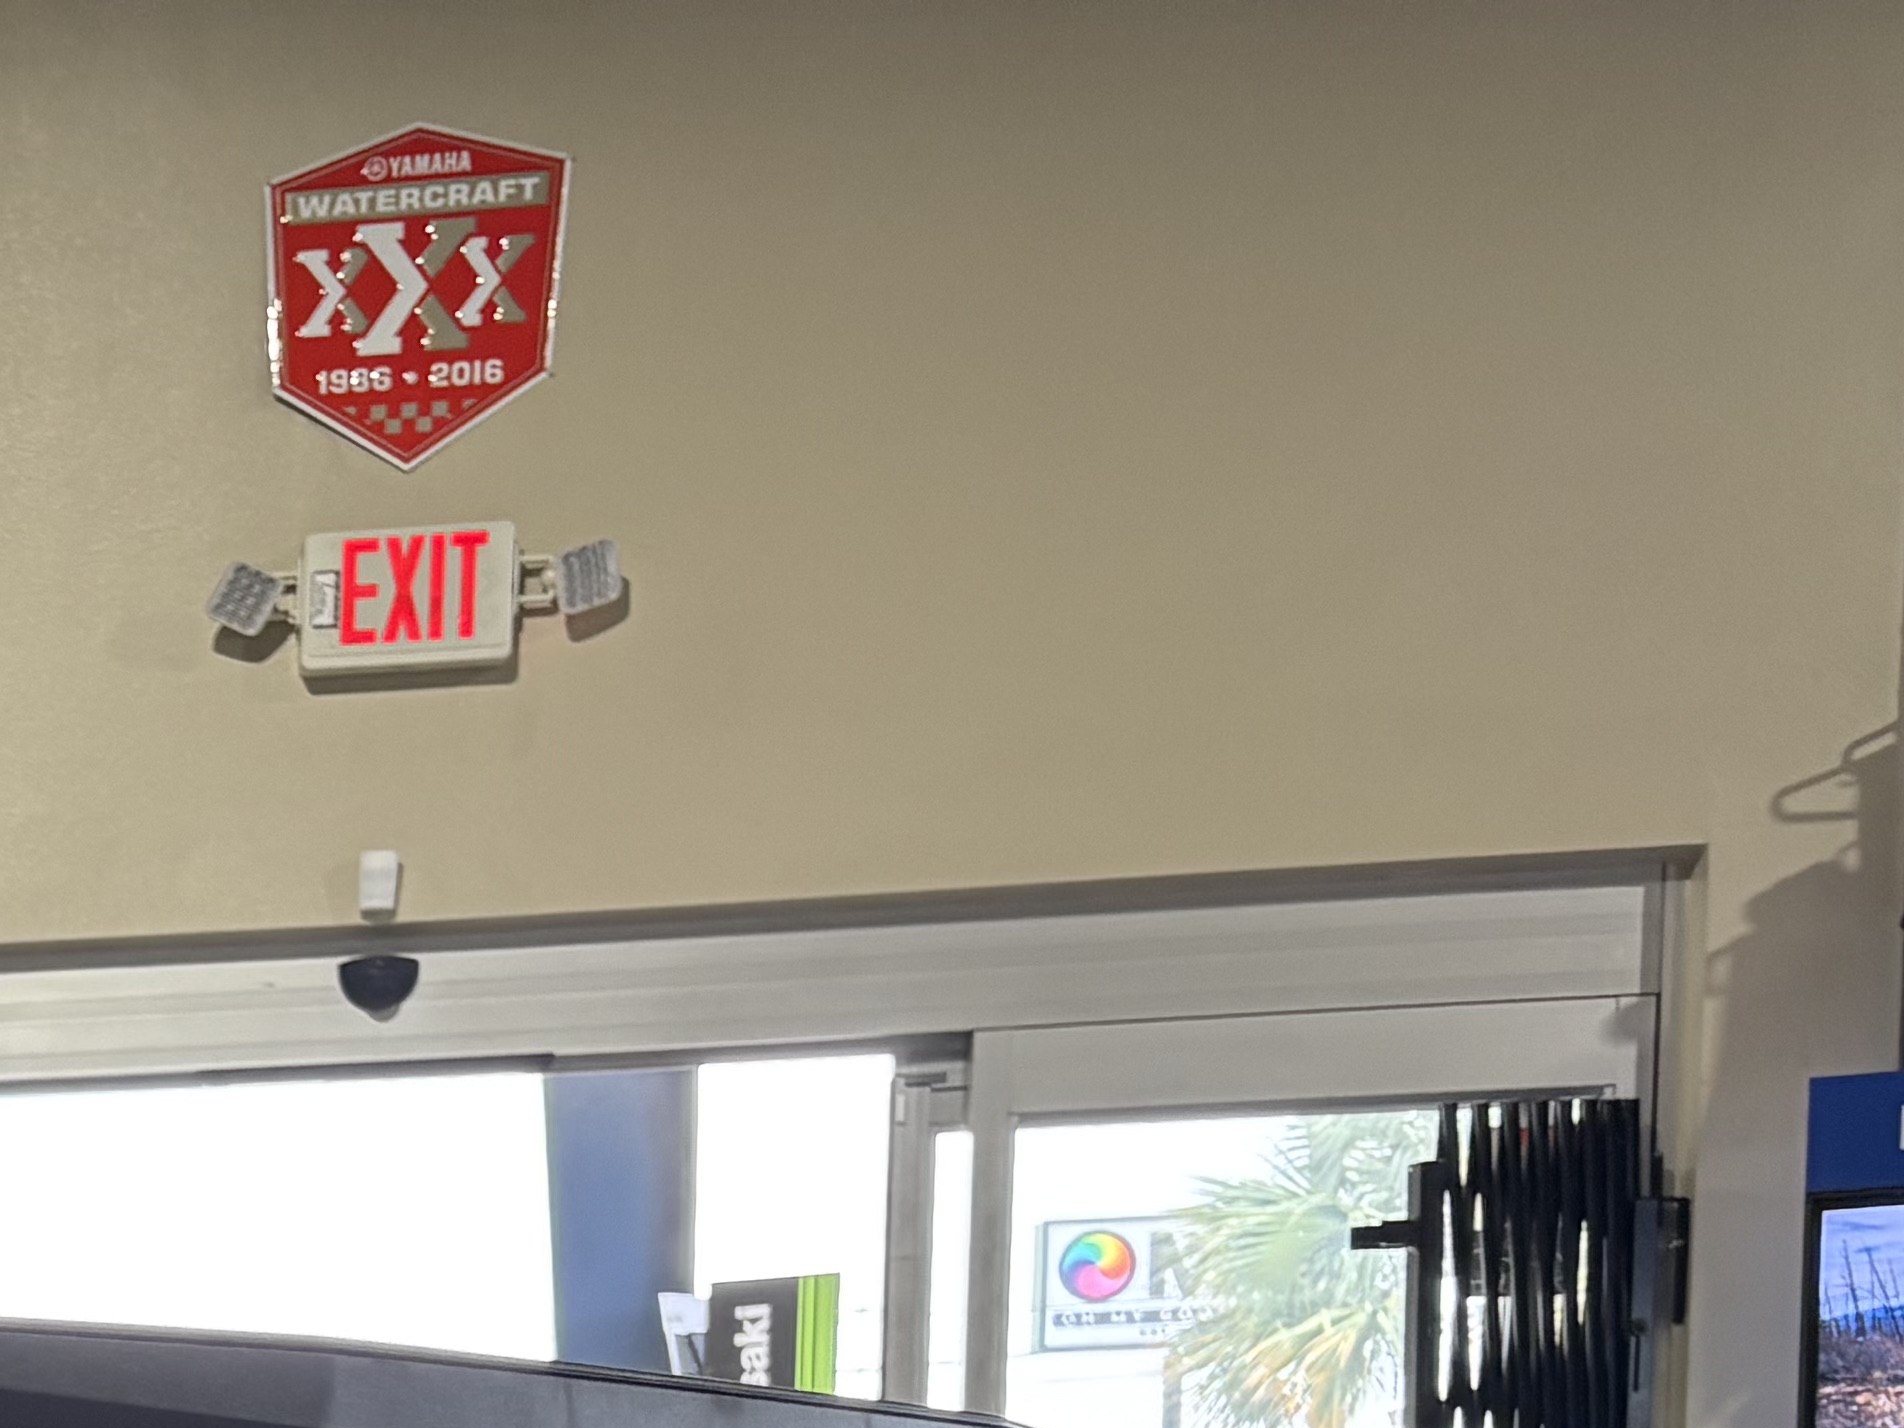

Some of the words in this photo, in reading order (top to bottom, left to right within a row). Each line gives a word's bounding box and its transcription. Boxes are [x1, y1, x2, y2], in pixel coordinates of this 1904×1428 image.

[390, 150, 471, 178] YAMAHA
[297, 177, 540, 218] WATERCRAFT
[316, 367, 393, 395] 1986
[428, 359, 505, 387] 2016
[339, 529, 491, 647] EXIT
